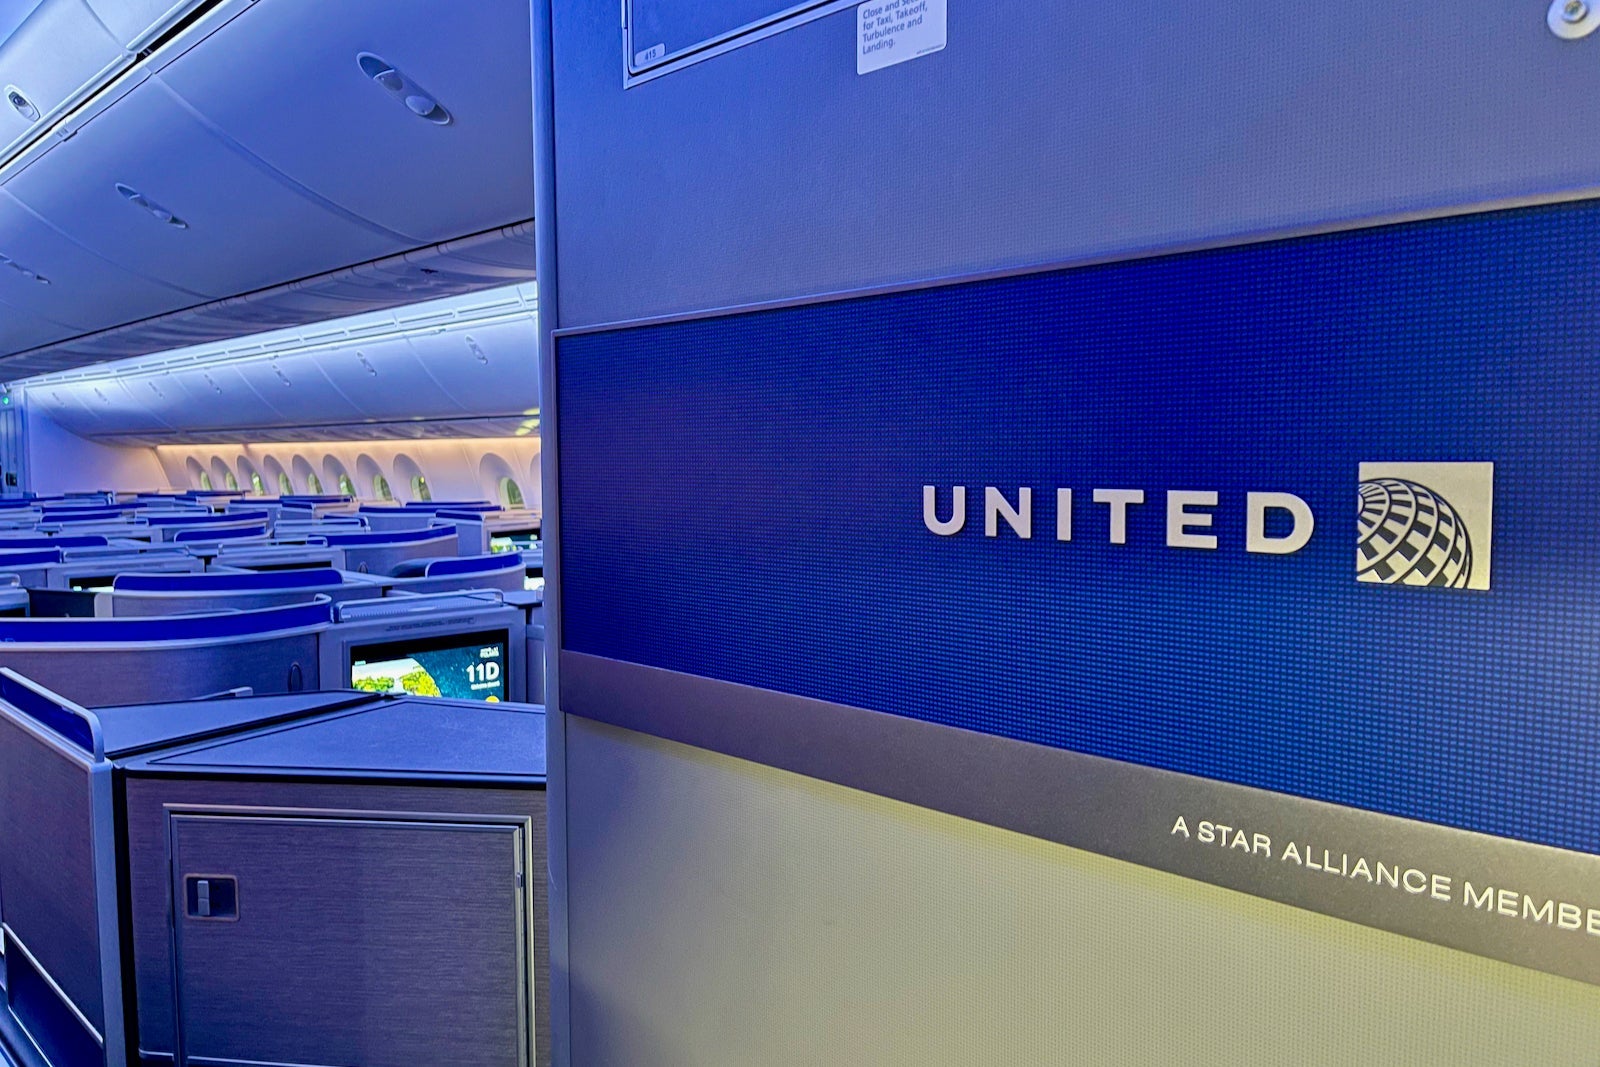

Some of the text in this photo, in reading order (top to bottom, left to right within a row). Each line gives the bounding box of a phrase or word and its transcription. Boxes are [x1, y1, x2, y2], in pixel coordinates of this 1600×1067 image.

[862, 2, 928, 31] for Taxi, Takeoff,
[863, 7, 883, 19] Close
[885, 0, 900, 12] and
[862, 14, 923, 43] Turbulence and
[862, 38, 896, 55] Landing.
[923, 485, 1315, 555] UNITED
[466, 661, 500, 683] 11D
[1171, 815, 1190, 839] A
[1197, 820, 1272, 858] STAR
[1281, 841, 1452, 902] ALLIANCE
